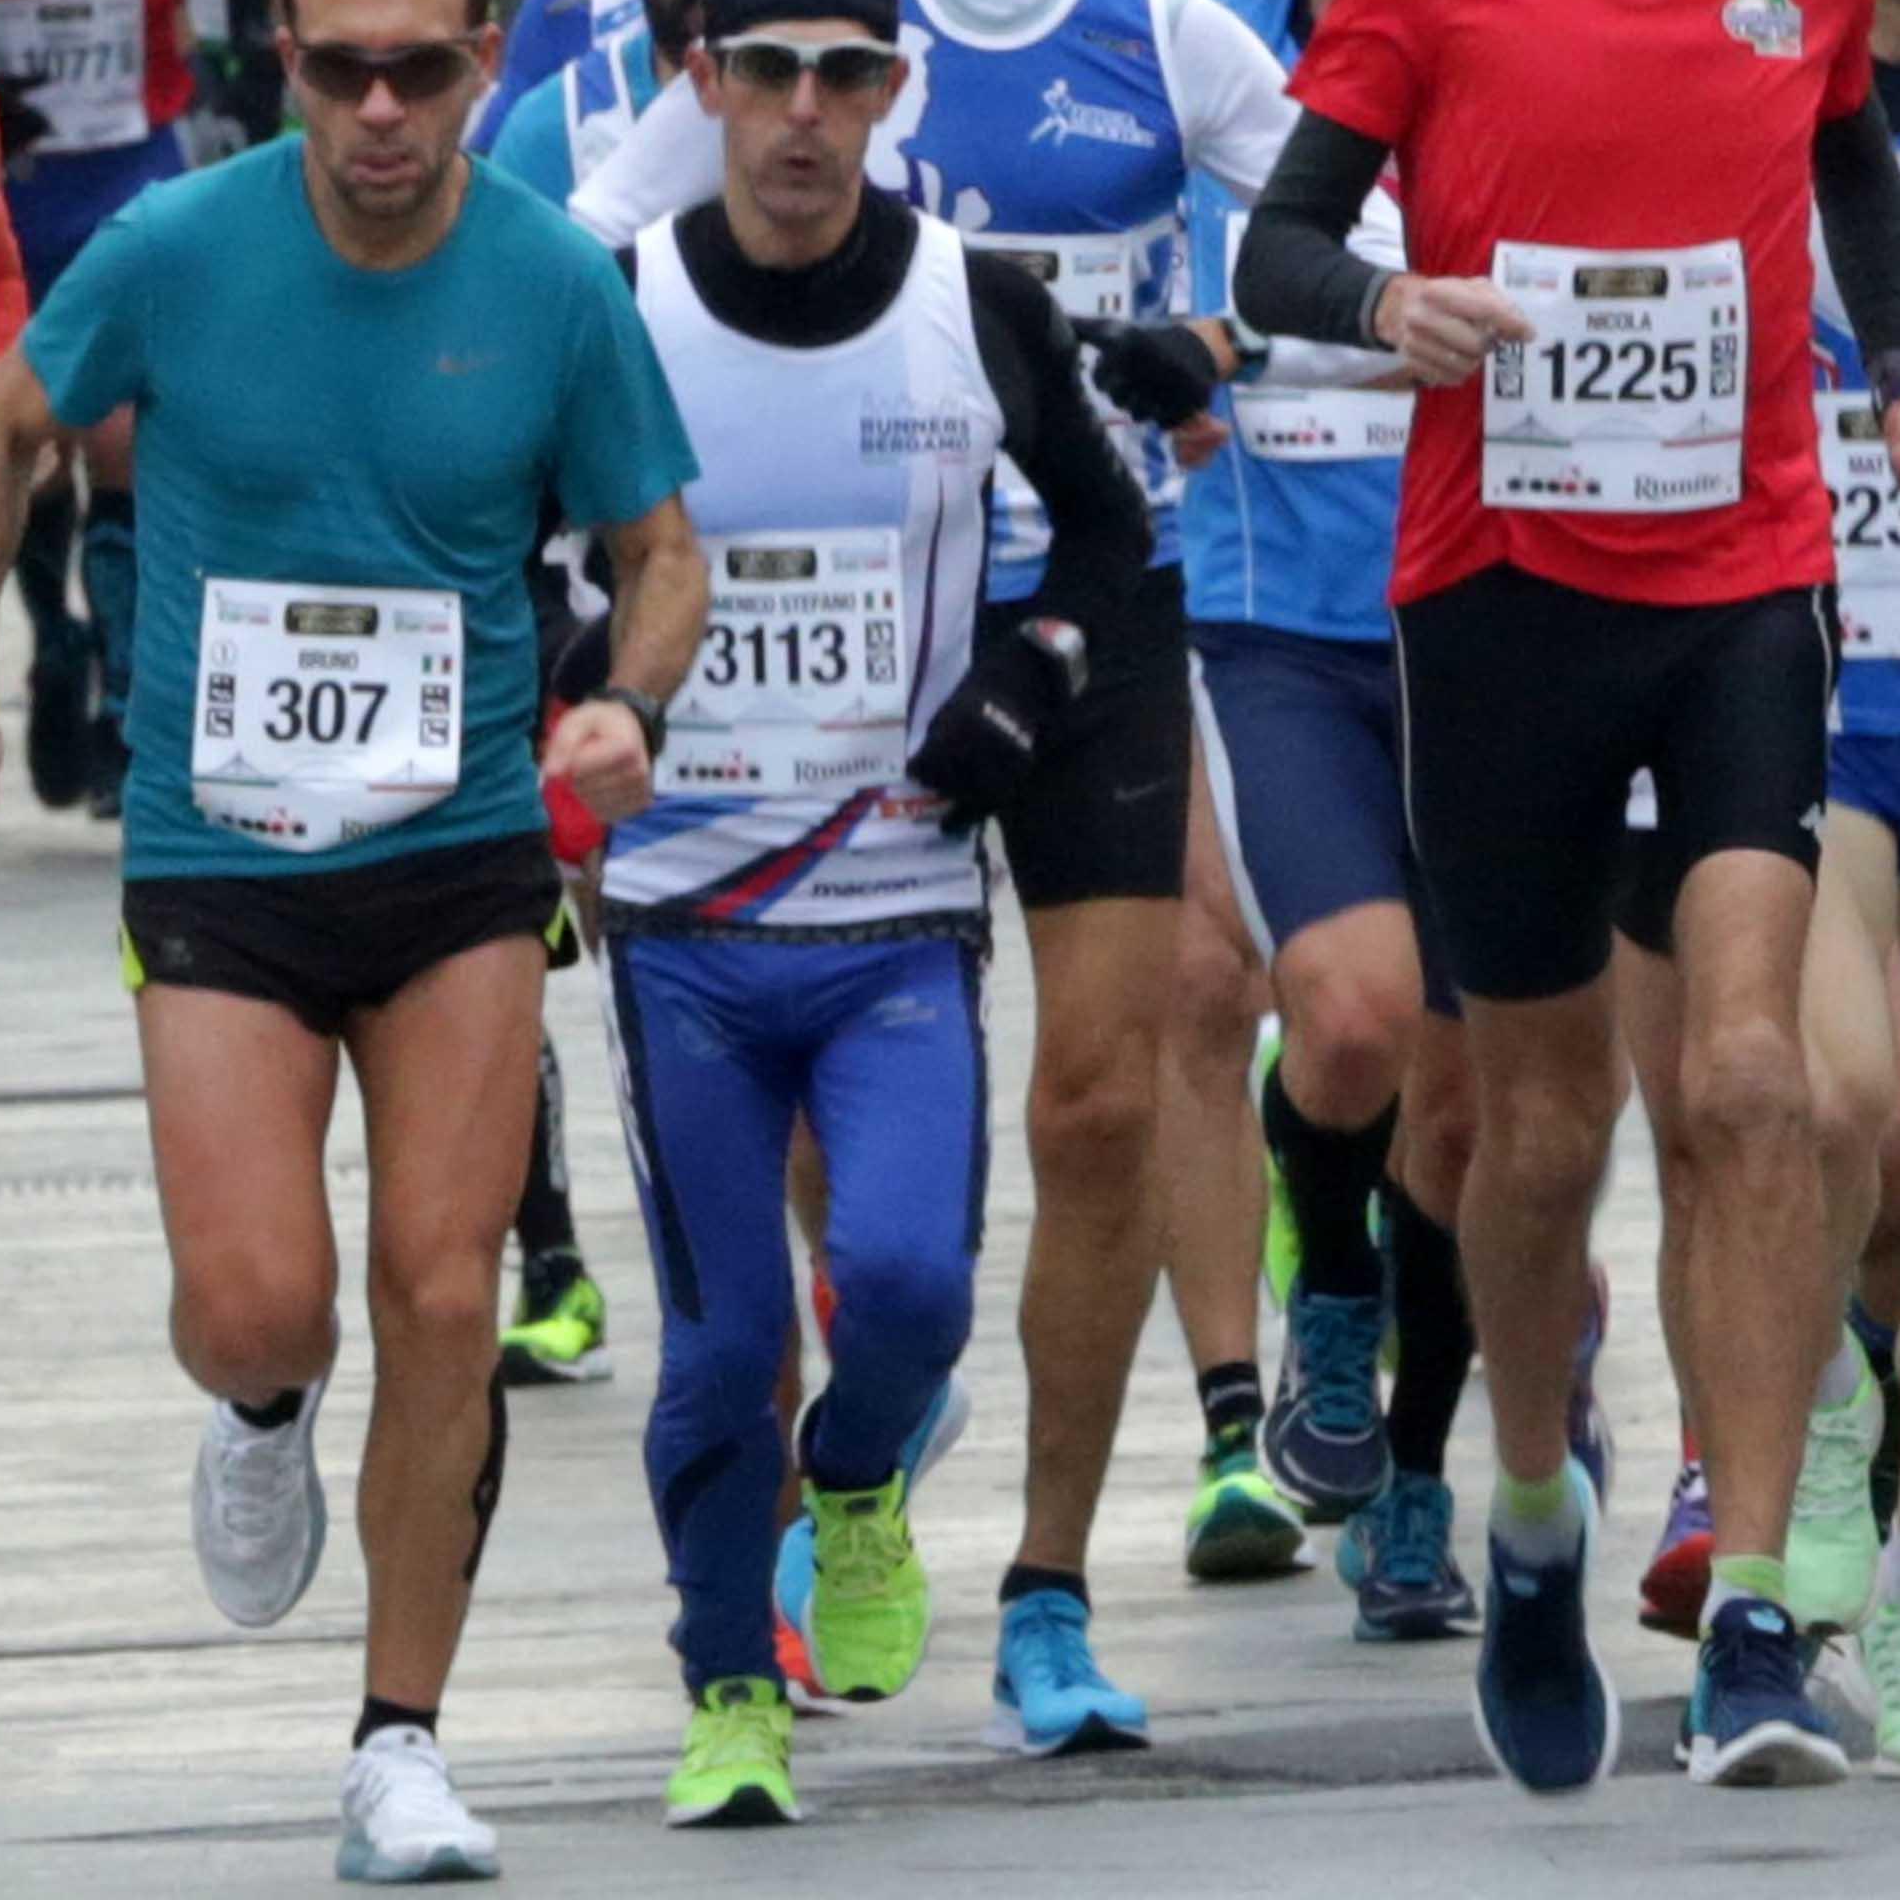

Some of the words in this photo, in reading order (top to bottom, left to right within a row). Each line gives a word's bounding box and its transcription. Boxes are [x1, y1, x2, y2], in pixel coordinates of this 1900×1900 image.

[1540, 339, 1697, 402] 1225
[298, 651, 358, 670] BRUNO
[702, 622, 848, 686] 3113
[264, 678, 389, 744] 307
